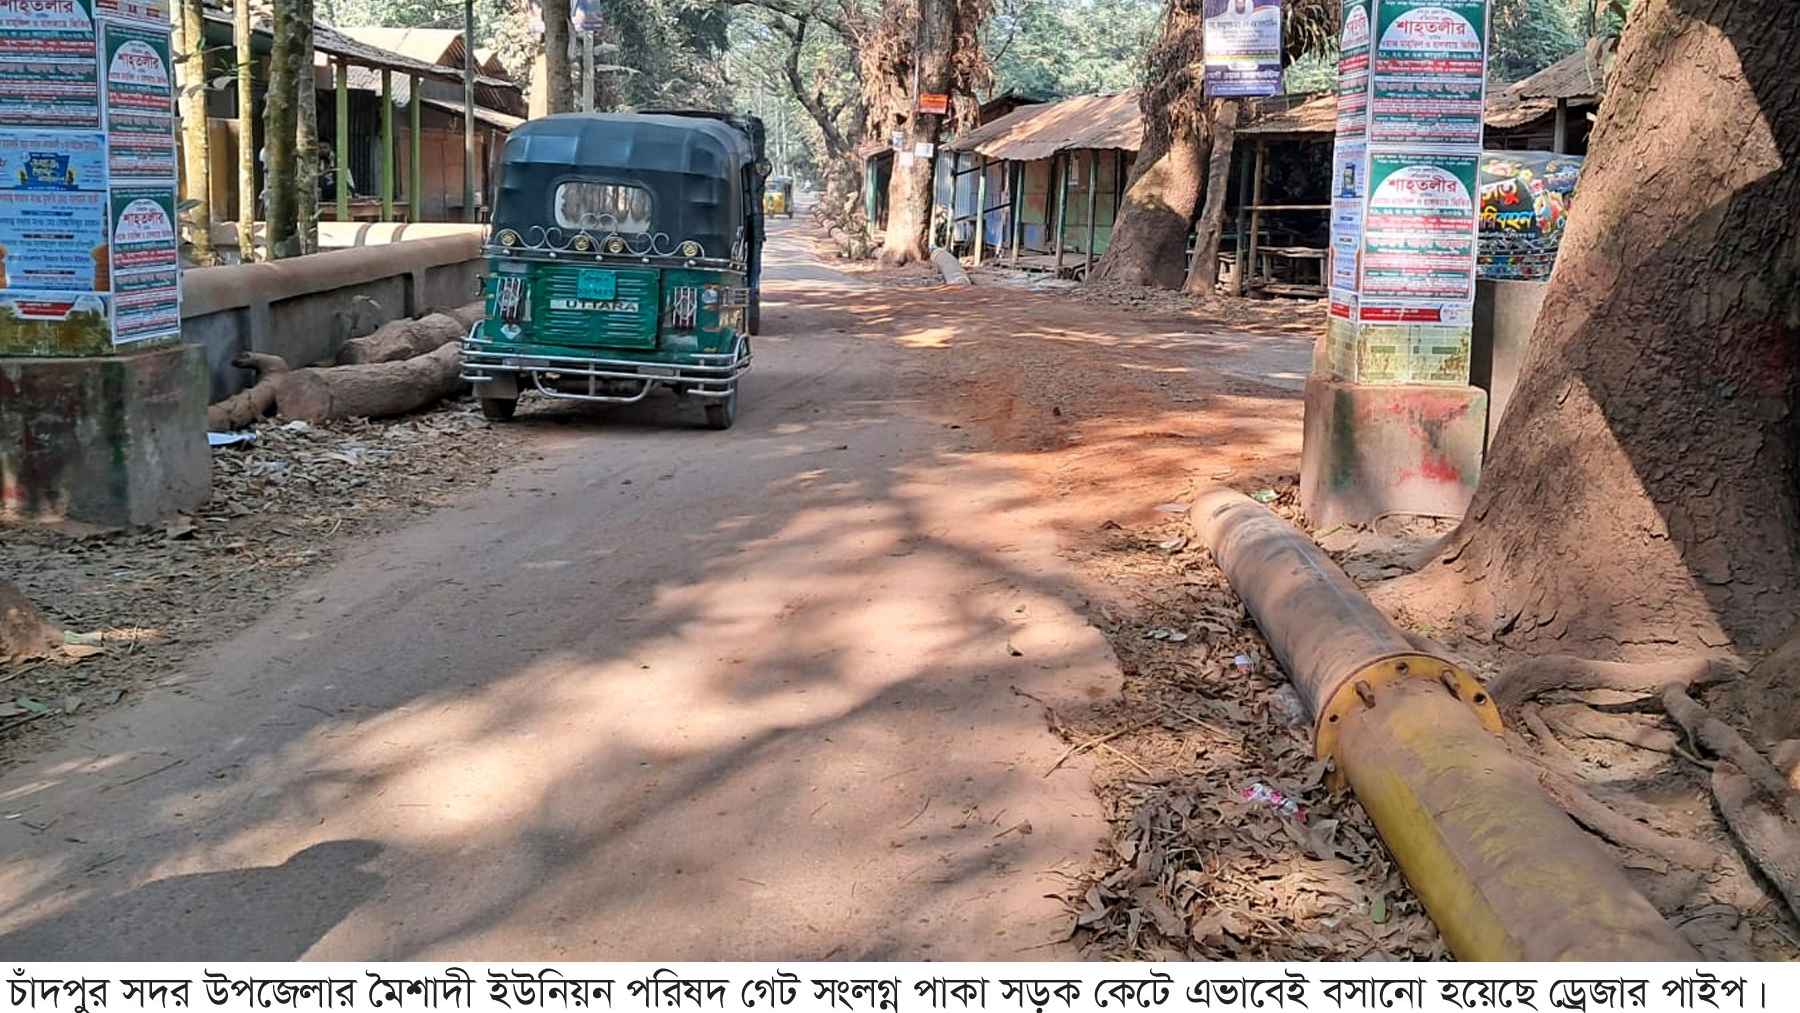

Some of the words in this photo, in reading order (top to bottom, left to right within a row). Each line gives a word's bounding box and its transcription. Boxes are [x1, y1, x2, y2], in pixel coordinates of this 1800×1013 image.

[1396, 17, 1466, 36] শাহতলীর
[1387, 175, 1457, 194] শাহতলীর
[565, 299, 637, 312] UTTARA
